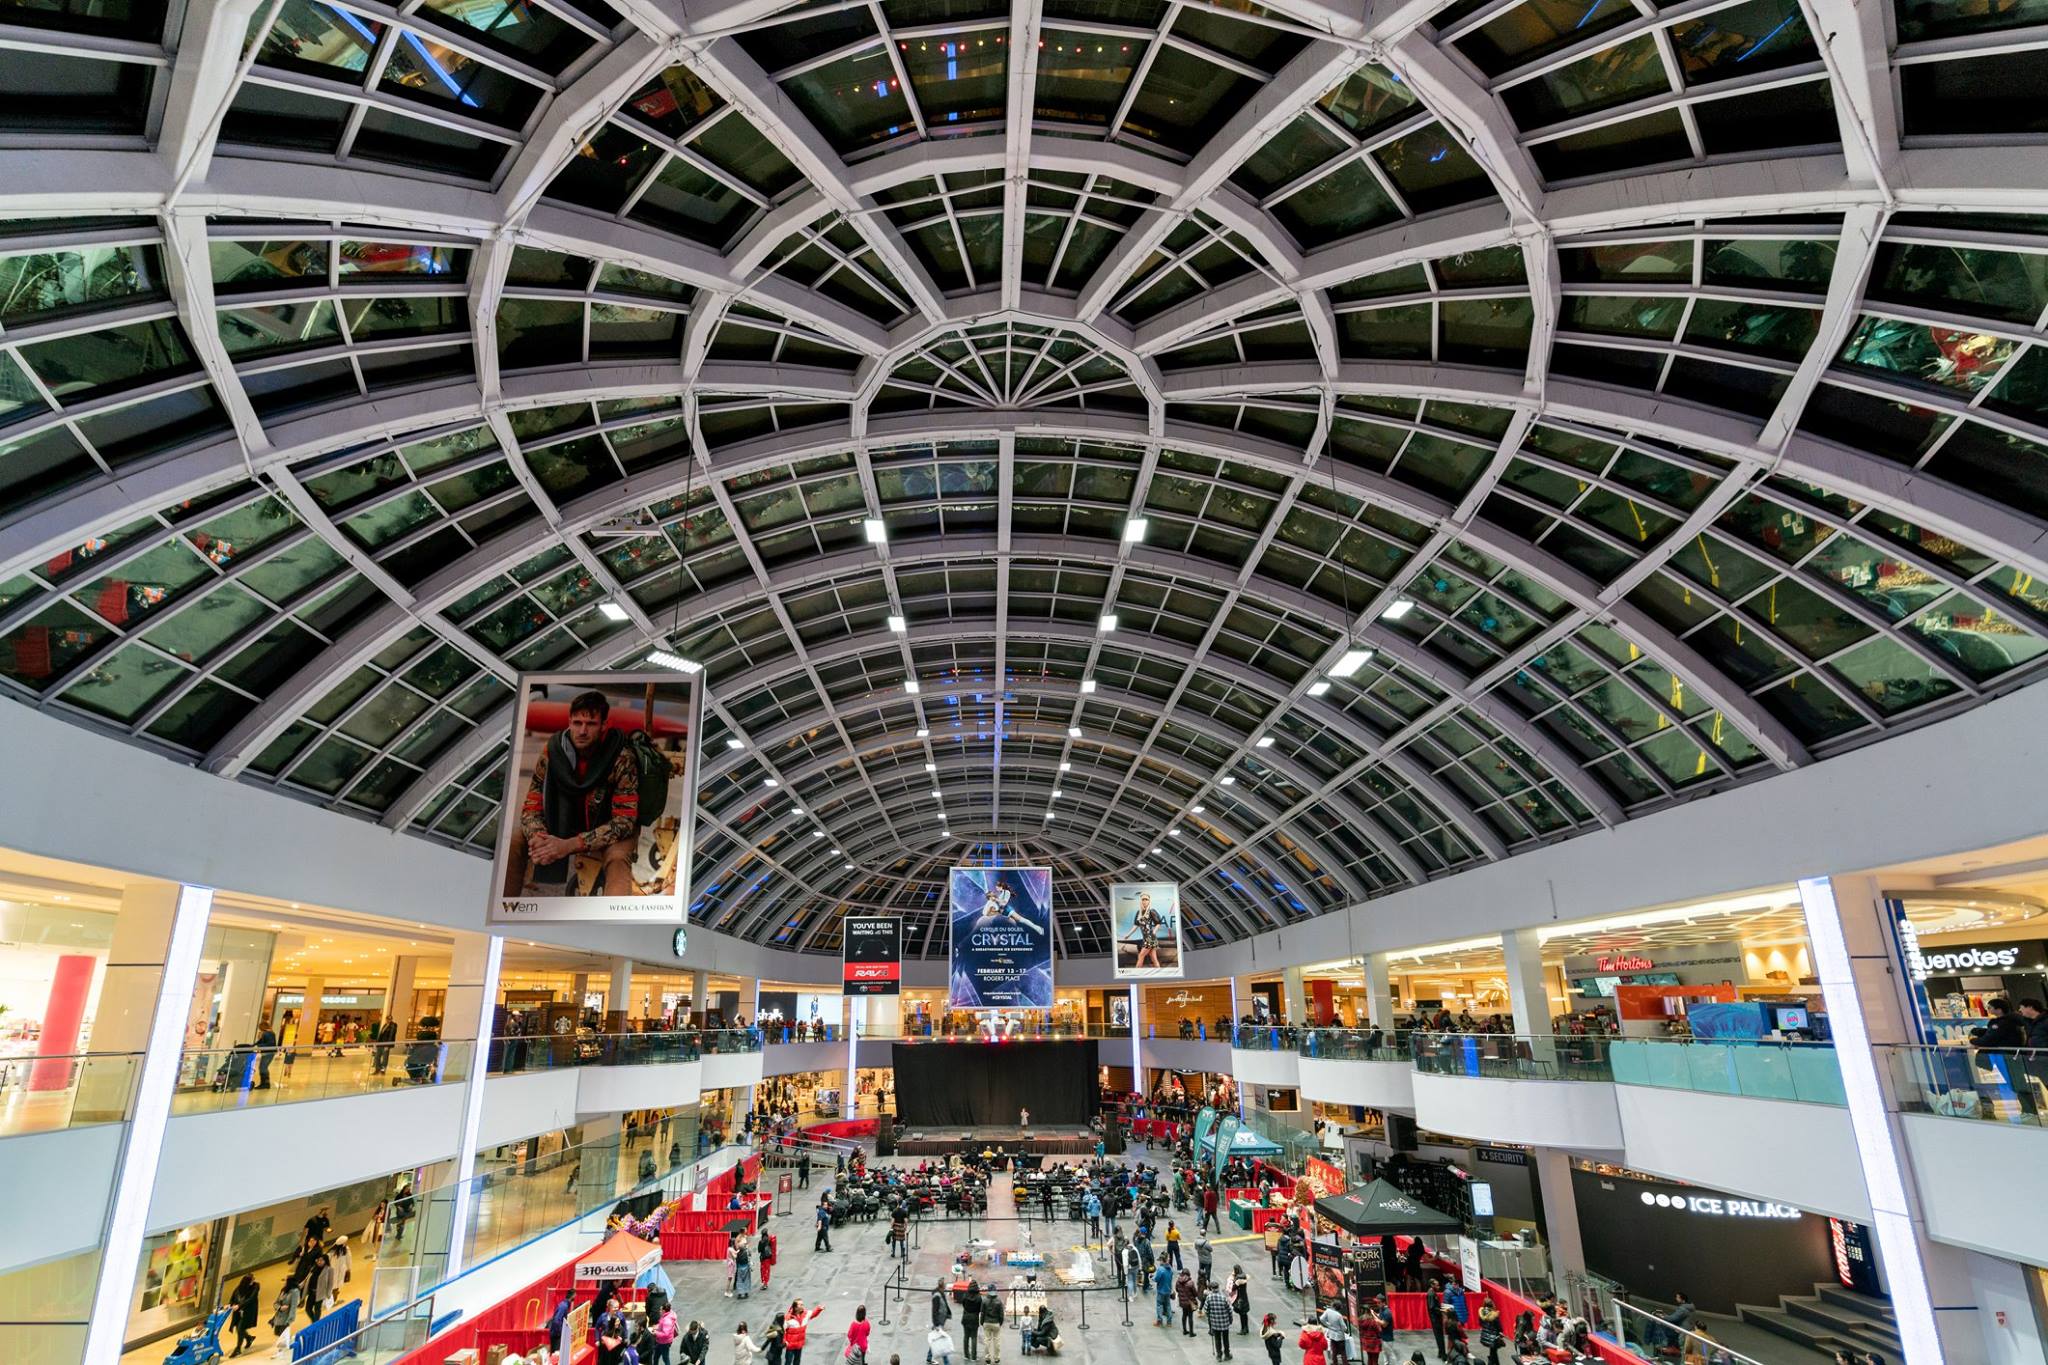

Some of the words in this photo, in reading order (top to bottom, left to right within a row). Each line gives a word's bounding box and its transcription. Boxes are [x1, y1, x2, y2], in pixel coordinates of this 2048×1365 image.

[971, 933, 1034, 946] CRYSTAL
[1597, 957, 1615, 972] Tim
[1616, 954, 1653, 970] Hortons
[1490, 1151, 1524, 1164] SECURITY
[1688, 1196, 1724, 1214] ICE
[1727, 1200, 1802, 1218] PALACE
[1355, 1250, 1380, 1259] CORK
